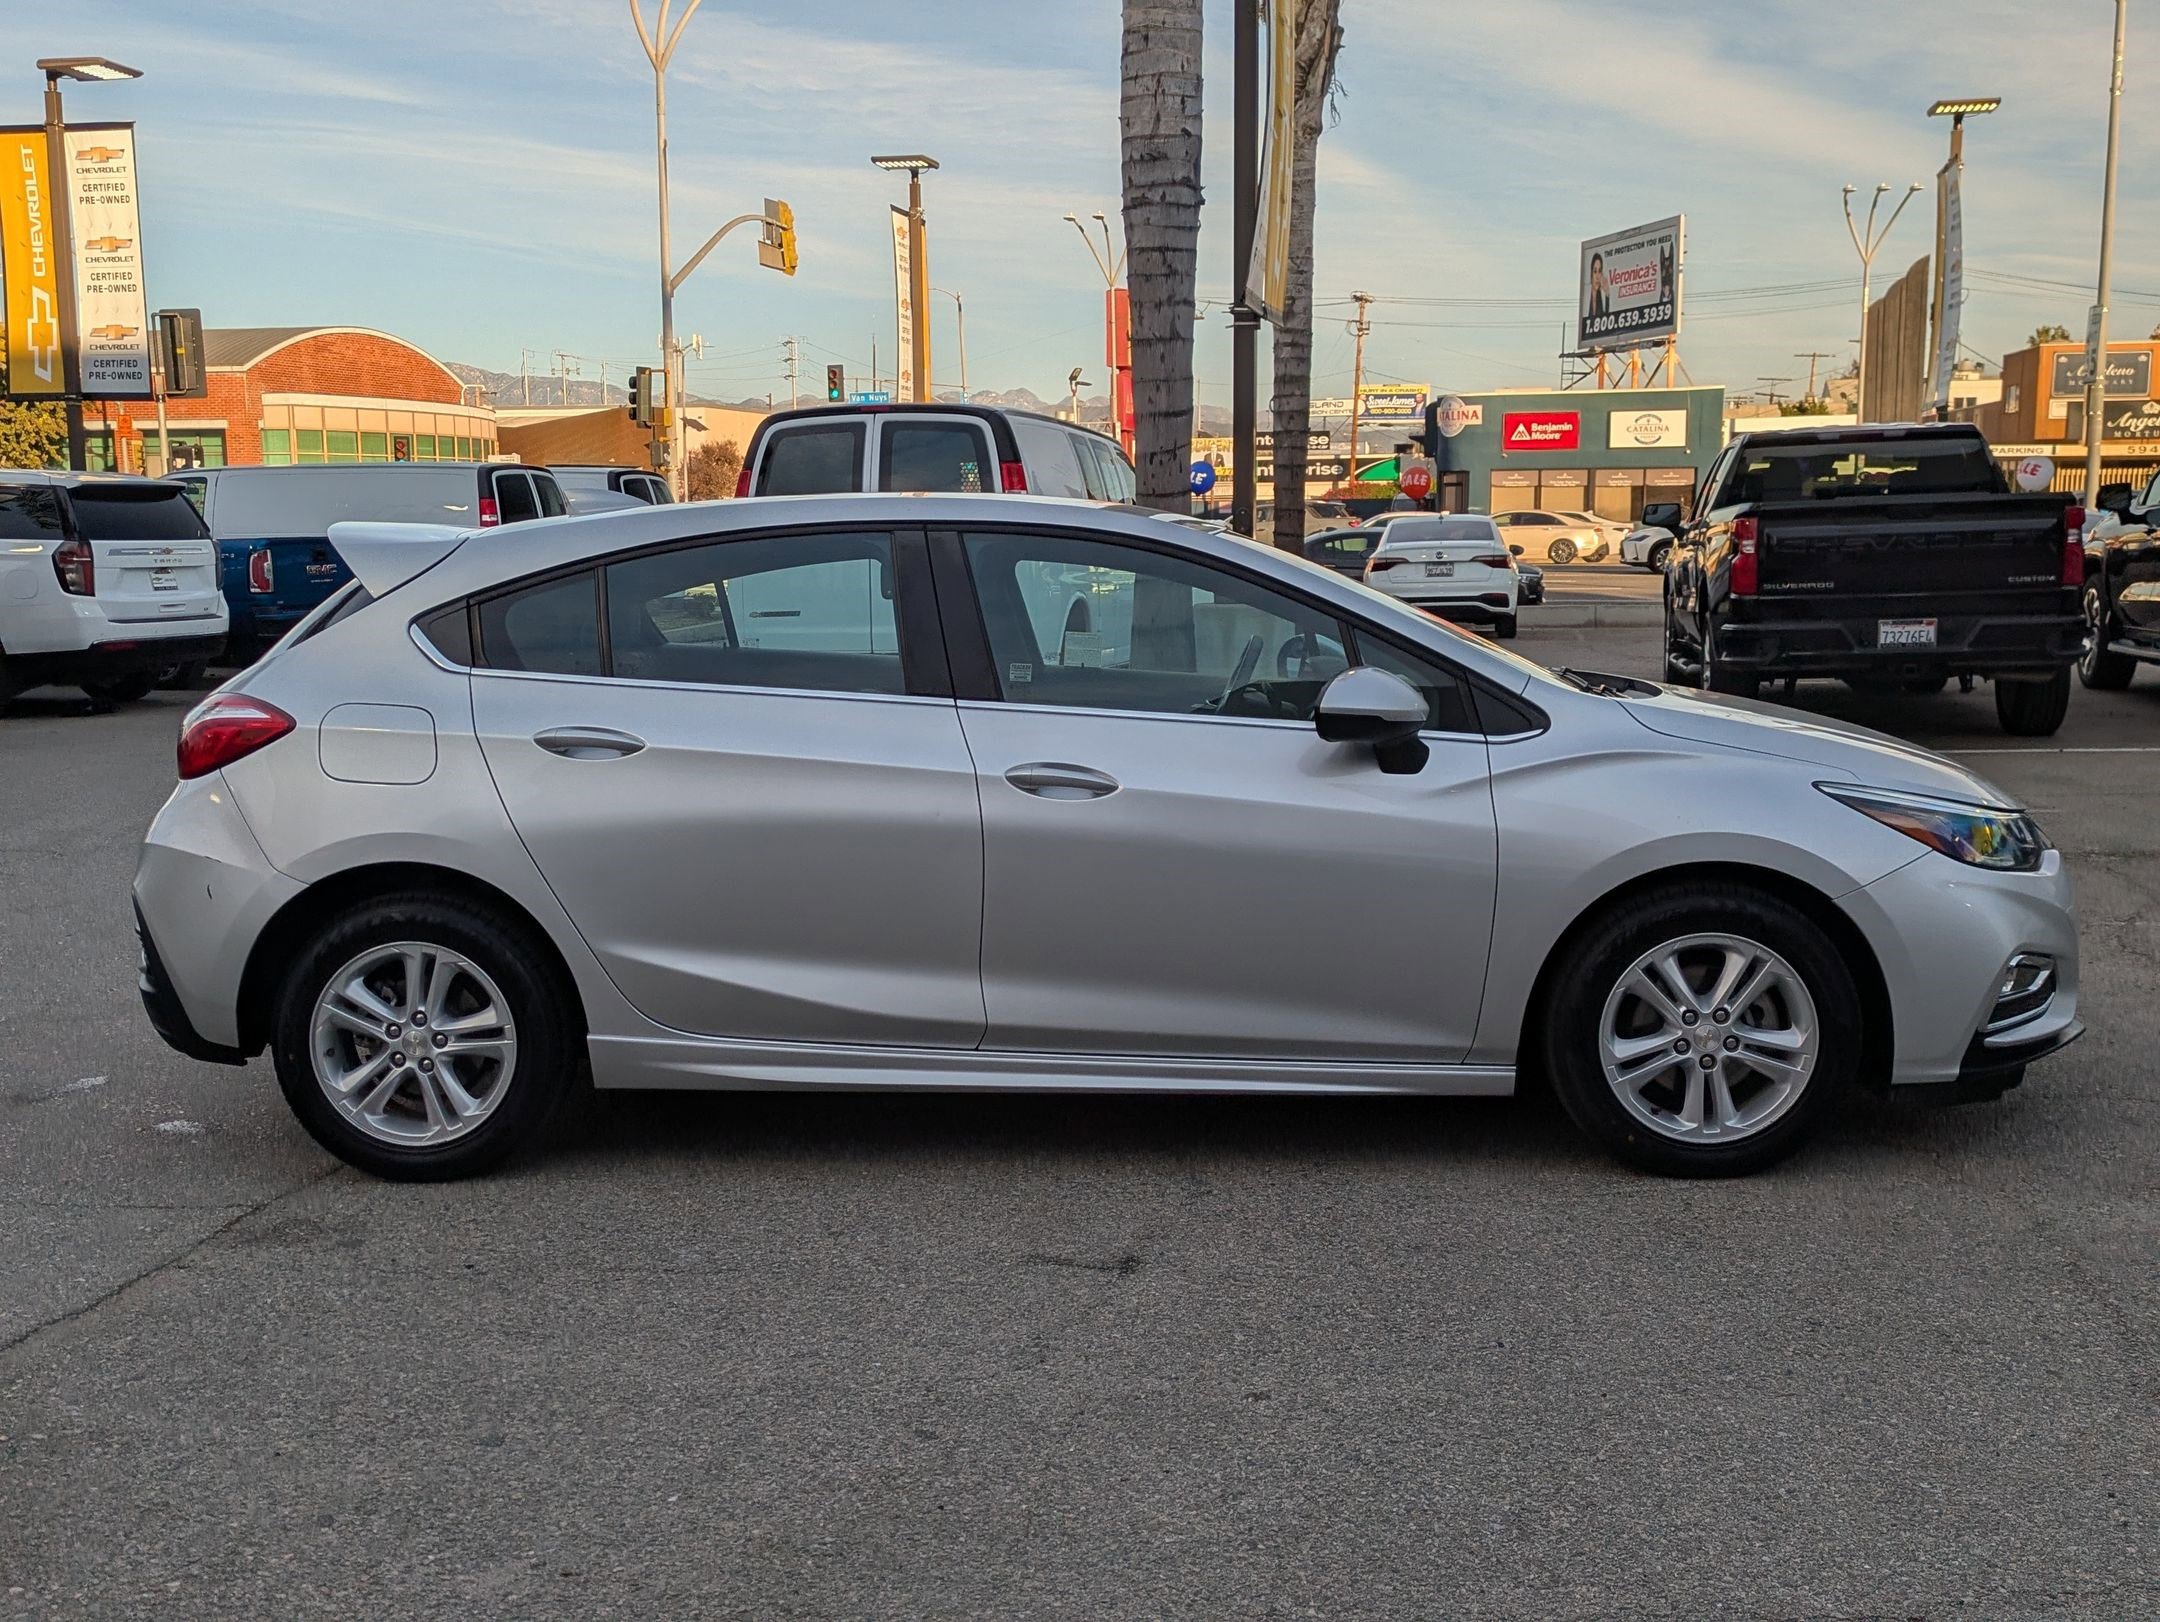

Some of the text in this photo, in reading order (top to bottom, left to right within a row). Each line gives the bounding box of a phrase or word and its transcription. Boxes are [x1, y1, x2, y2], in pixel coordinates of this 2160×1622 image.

[76, 166, 127, 174] CHEVROLET
[82, 182, 126, 192] CERTIFIED
[79, 195, 131, 205] PRE-OWNED
[20, 144, 46, 277] CHEVROLET
[1604, 234, 1672, 258] THE PROTECTION YOU NEED
[90, 271, 133, 281] CERTIFIED
[1608, 259, 1657, 286] Veronica's
[86, 284, 138, 293] PRE-OWNED
[1619, 280, 1656, 297] INSURANCE
[1585, 304, 1672, 334] 1.800.639.3939
[93, 359, 138, 368] CERTIFIED
[88, 371, 143, 380] PRE-OWNED
[1440, 410, 1479, 421] TALINA
[1531, 422, 1573, 432] Benjamin
[1626, 425, 1670, 433] CATALINA
[1531, 431, 1561, 440] Moore
[2020, 463, 2042, 476] LE
[1191, 471, 1207, 484] LE
[2008, 575, 2056, 583] CUSTOM
